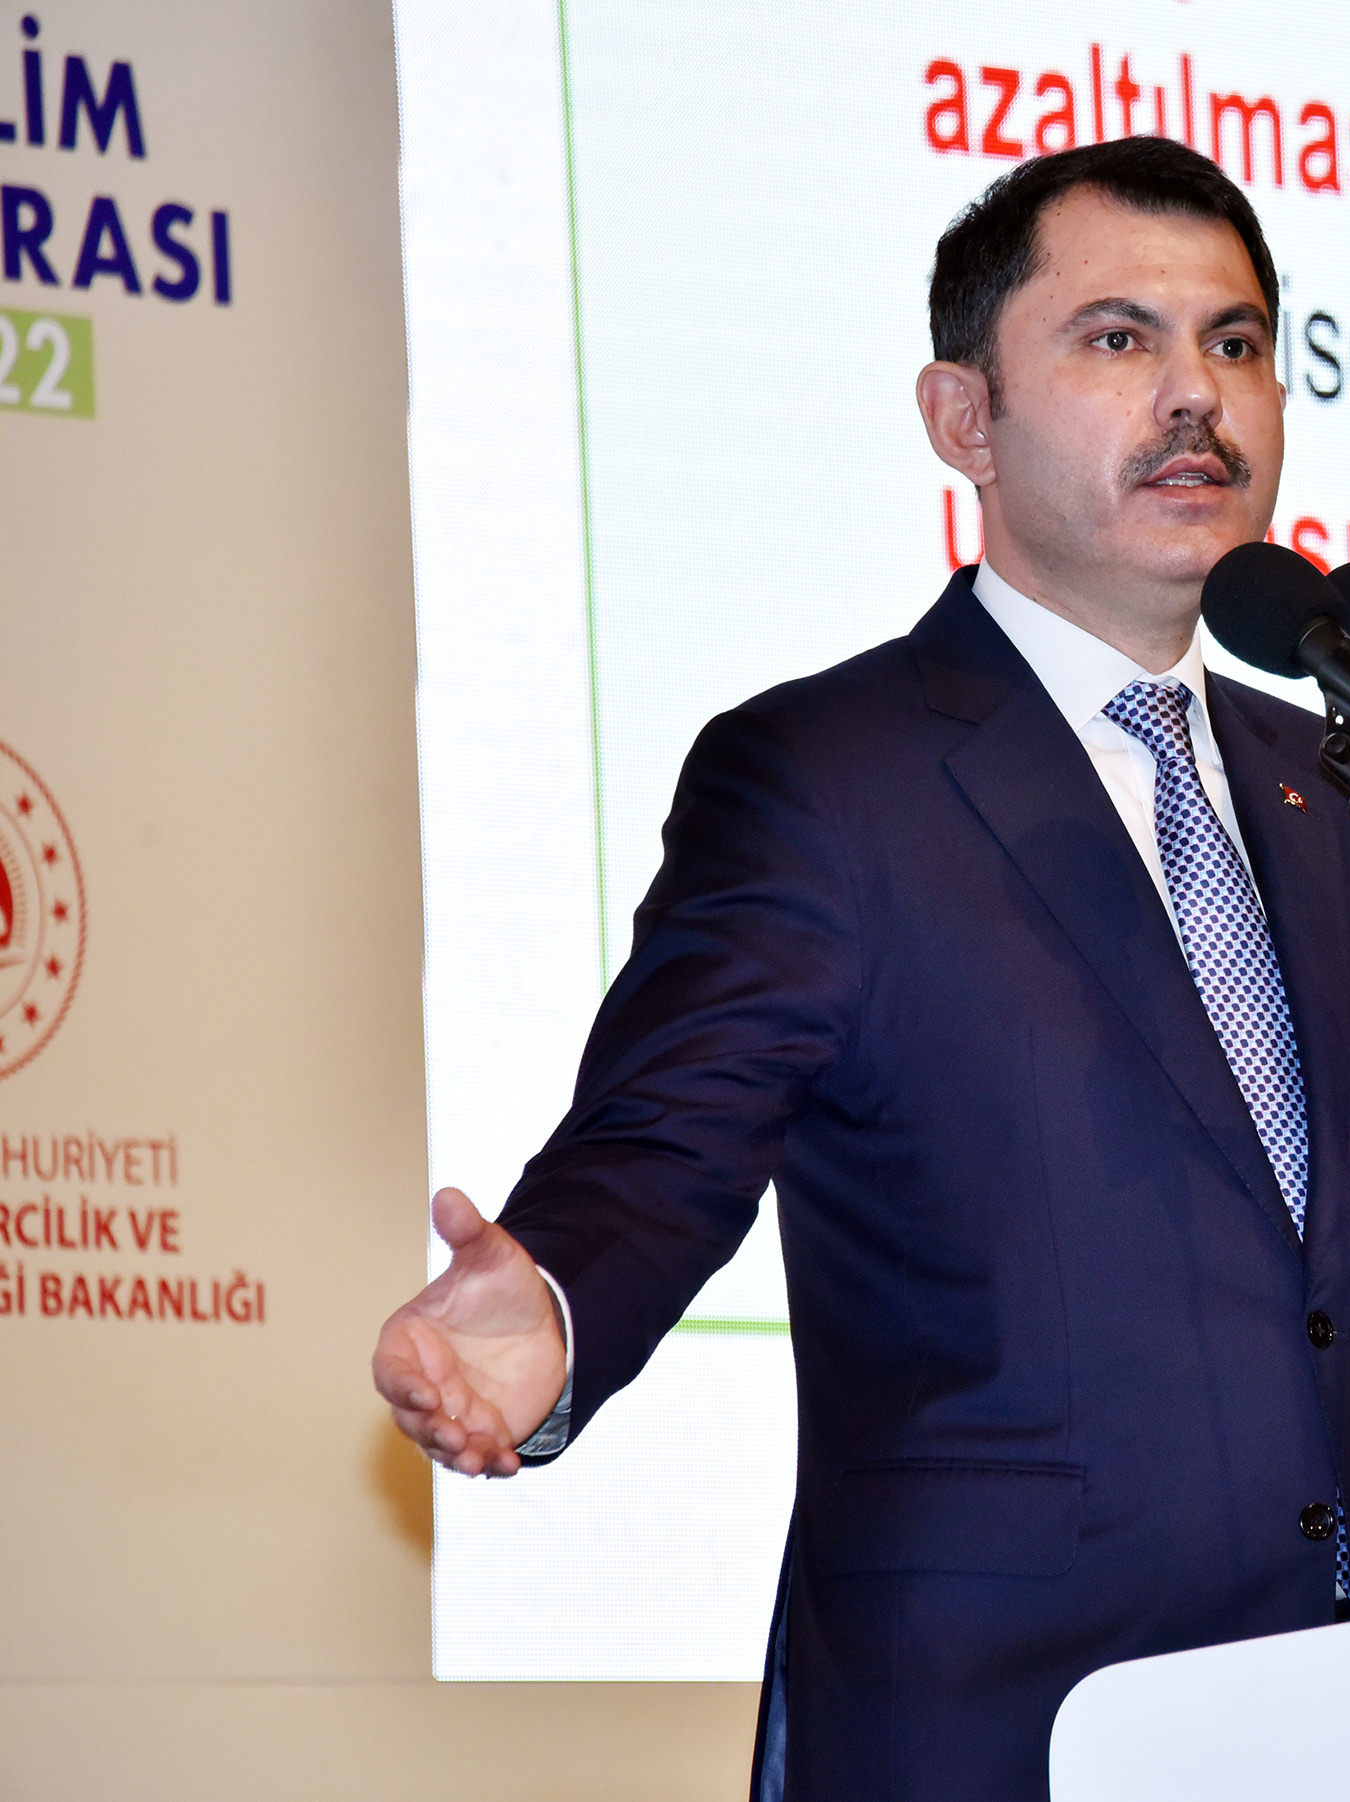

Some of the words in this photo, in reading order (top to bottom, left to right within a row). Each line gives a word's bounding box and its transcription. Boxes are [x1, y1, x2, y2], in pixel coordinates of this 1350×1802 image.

[0, 14, 146, 159] İM
[0, 184, 231, 306] RASI
[1, 1130, 179, 1186] HURİYETİ
[128, 1208, 180, 1253] VE
[39, 1269, 265, 1324] BAKANLIĞI
